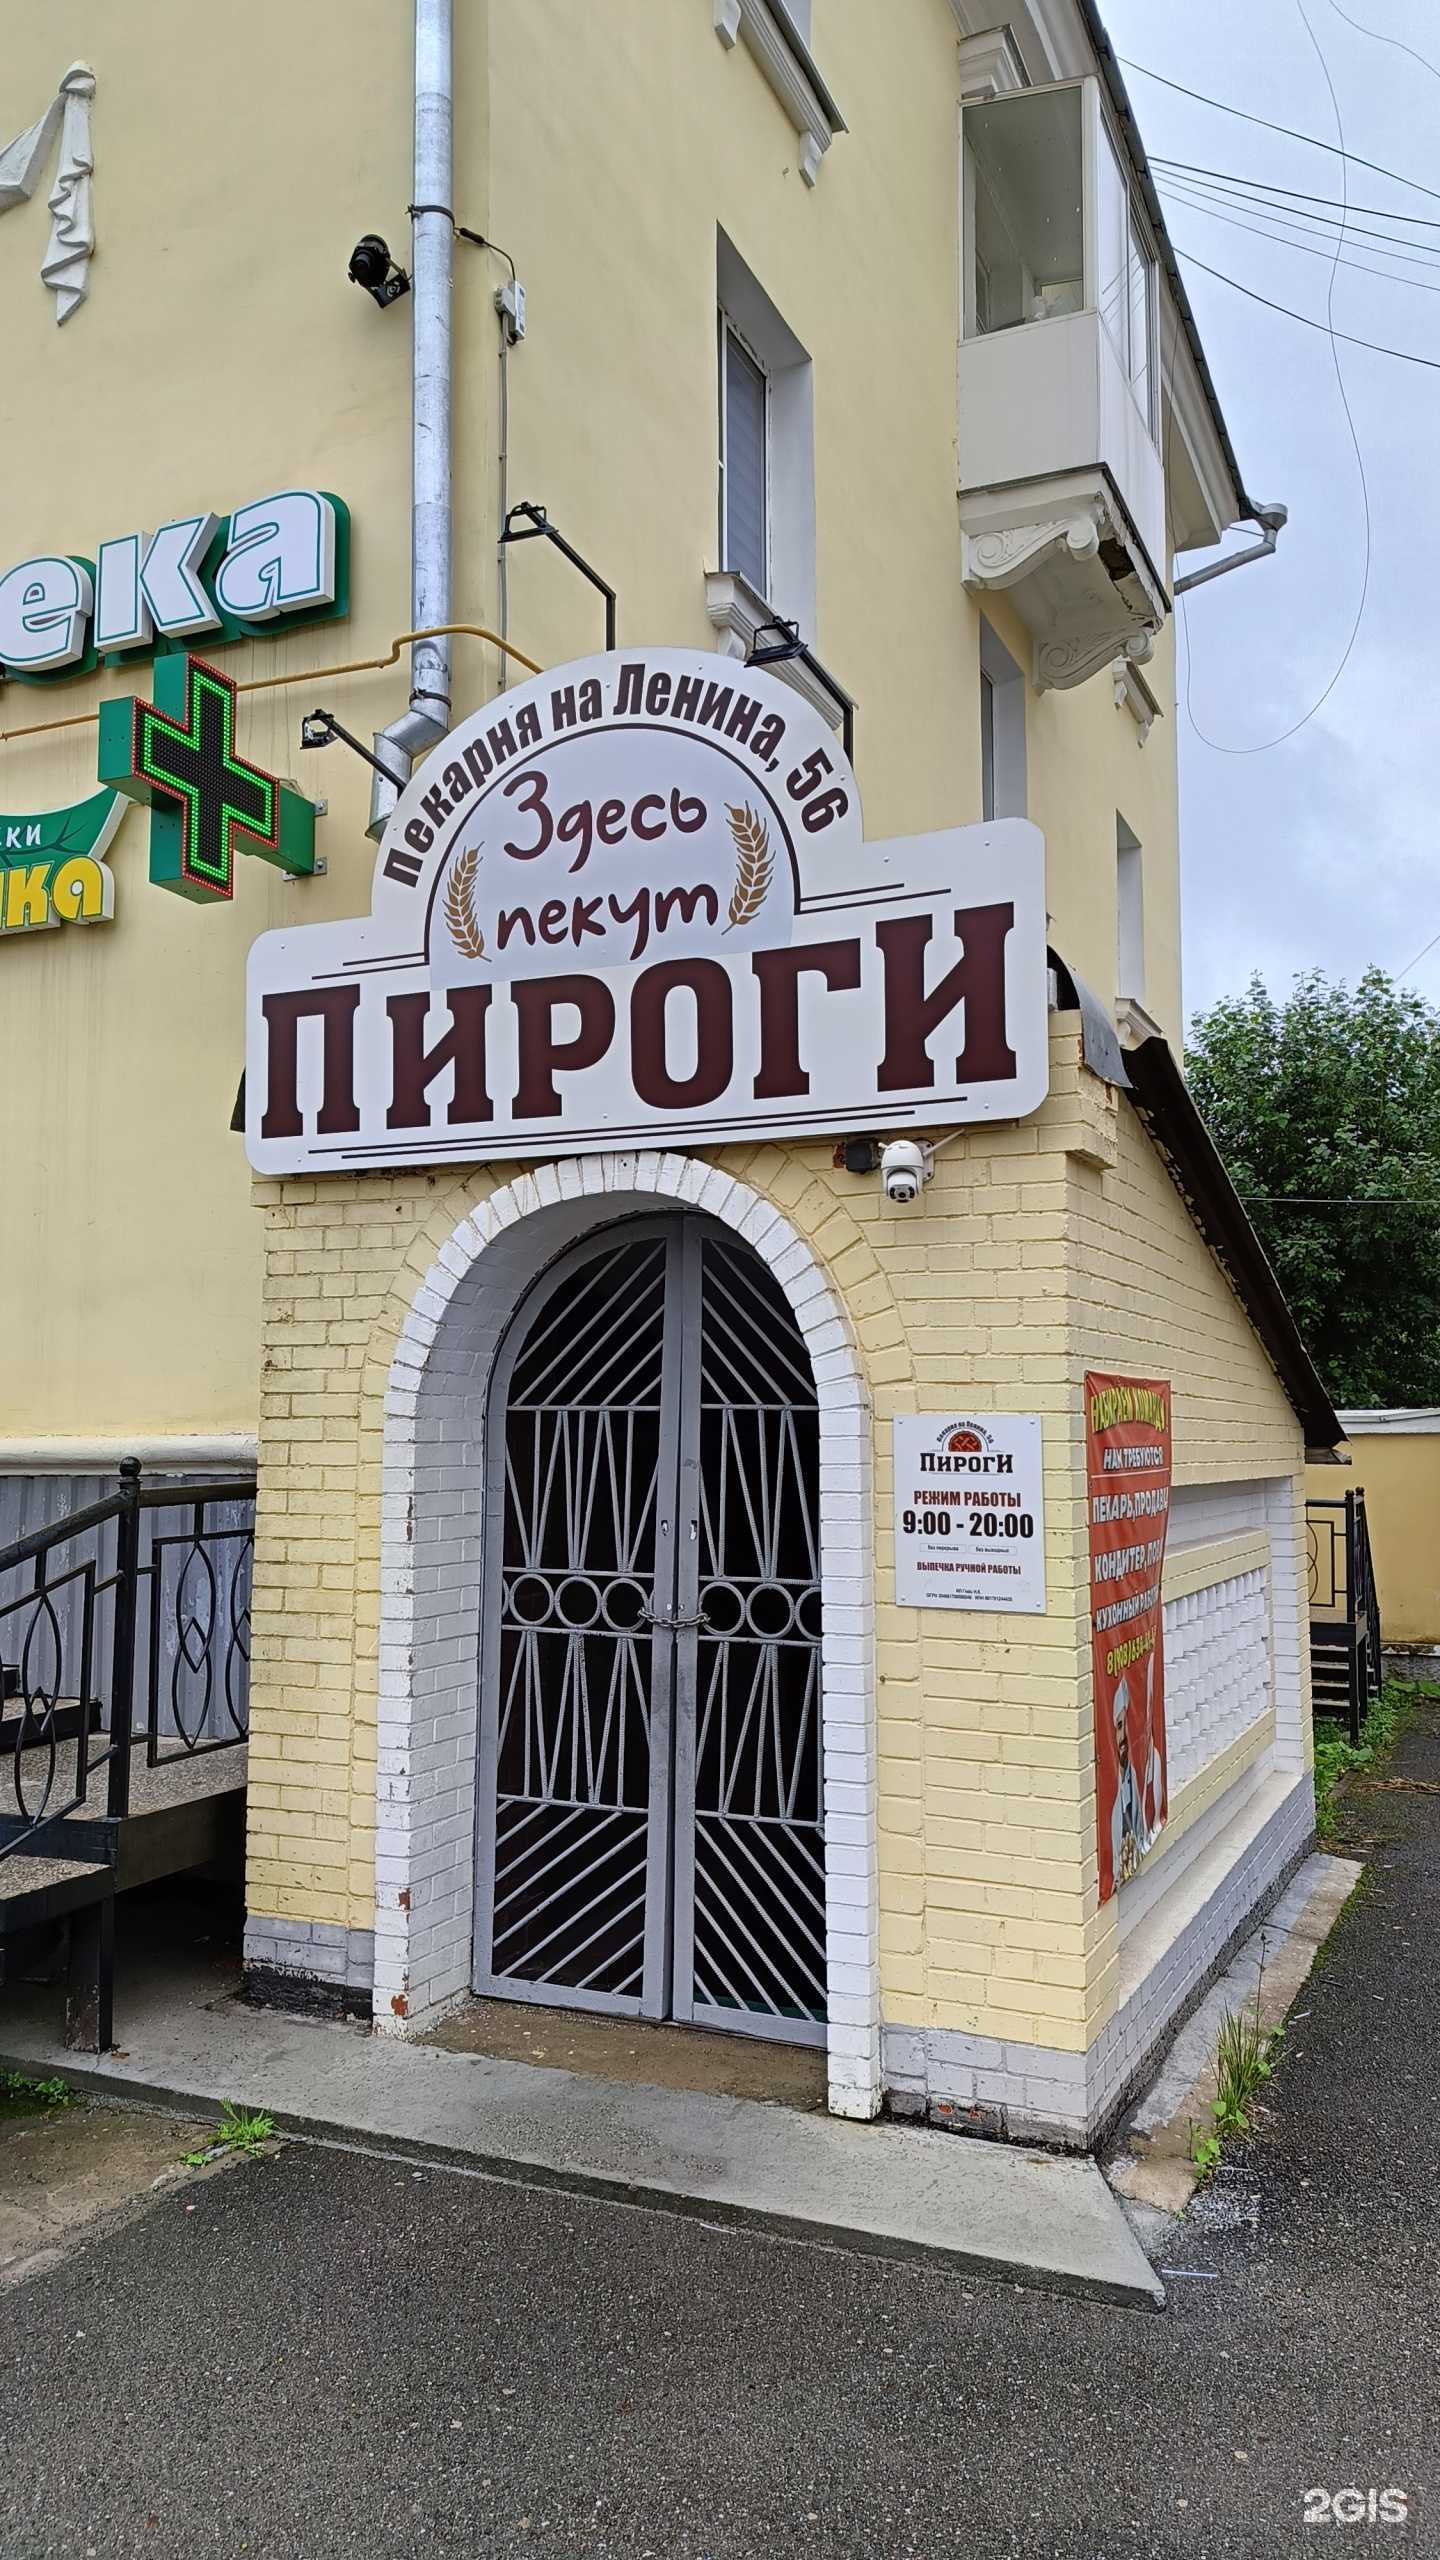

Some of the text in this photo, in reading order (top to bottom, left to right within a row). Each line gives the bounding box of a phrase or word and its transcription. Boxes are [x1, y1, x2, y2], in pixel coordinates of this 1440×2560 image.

[383, 663, 850, 888] Пекарня на Ленина, 56
[503, 770, 708, 874] Здесь
[496, 883, 720, 961] пекут
[261, 901, 1018, 1139] ПИРОГИ
[903, 1510, 951, 1535] 9:00
[969, 1512, 1034, 1538] 20:00
[914, 1490, 1021, 1508] РЕЖИМ РАБОТЫ
[916, 1562, 1021, 1575] ВЫПЕЧКА РУЧНОЙ РАБОТЫ
